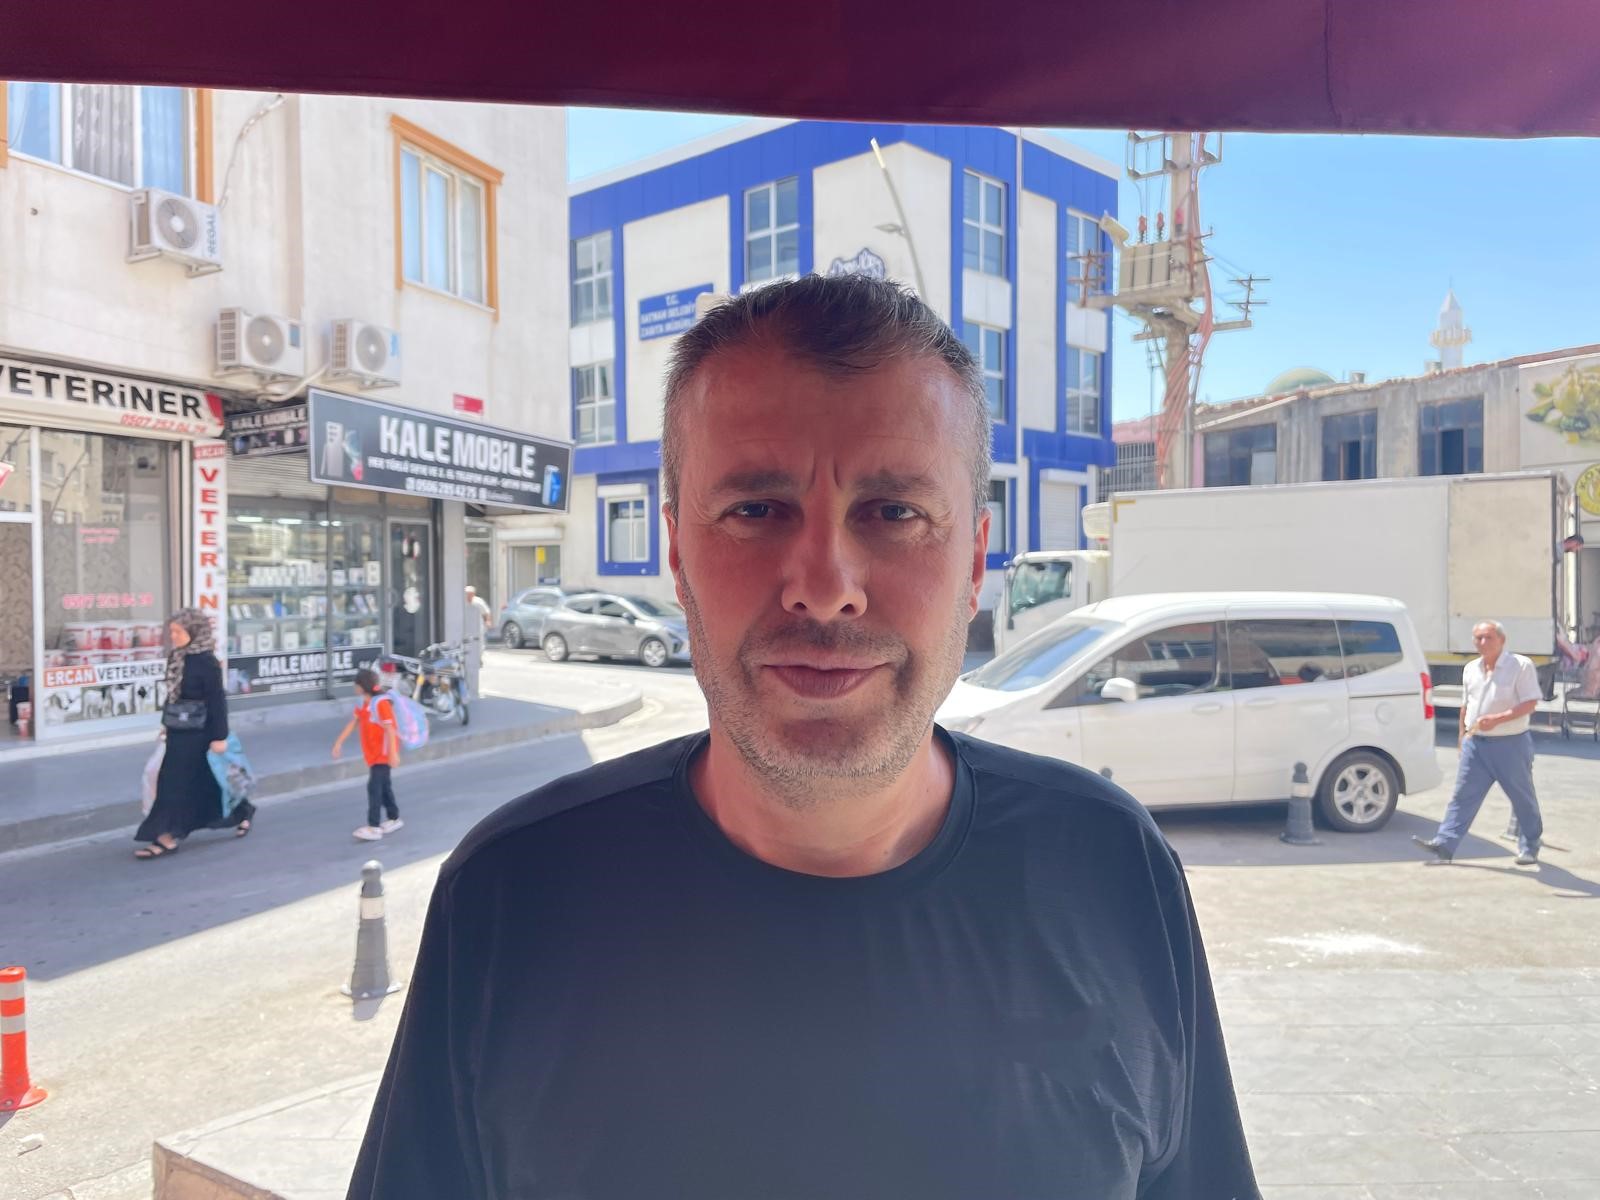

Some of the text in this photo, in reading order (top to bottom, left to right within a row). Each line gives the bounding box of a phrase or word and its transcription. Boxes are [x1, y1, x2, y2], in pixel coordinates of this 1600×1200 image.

[379, 415, 450, 464] KALE
[46, 667, 94, 687] ERCAN
[259, 655, 299, 677] KALE
